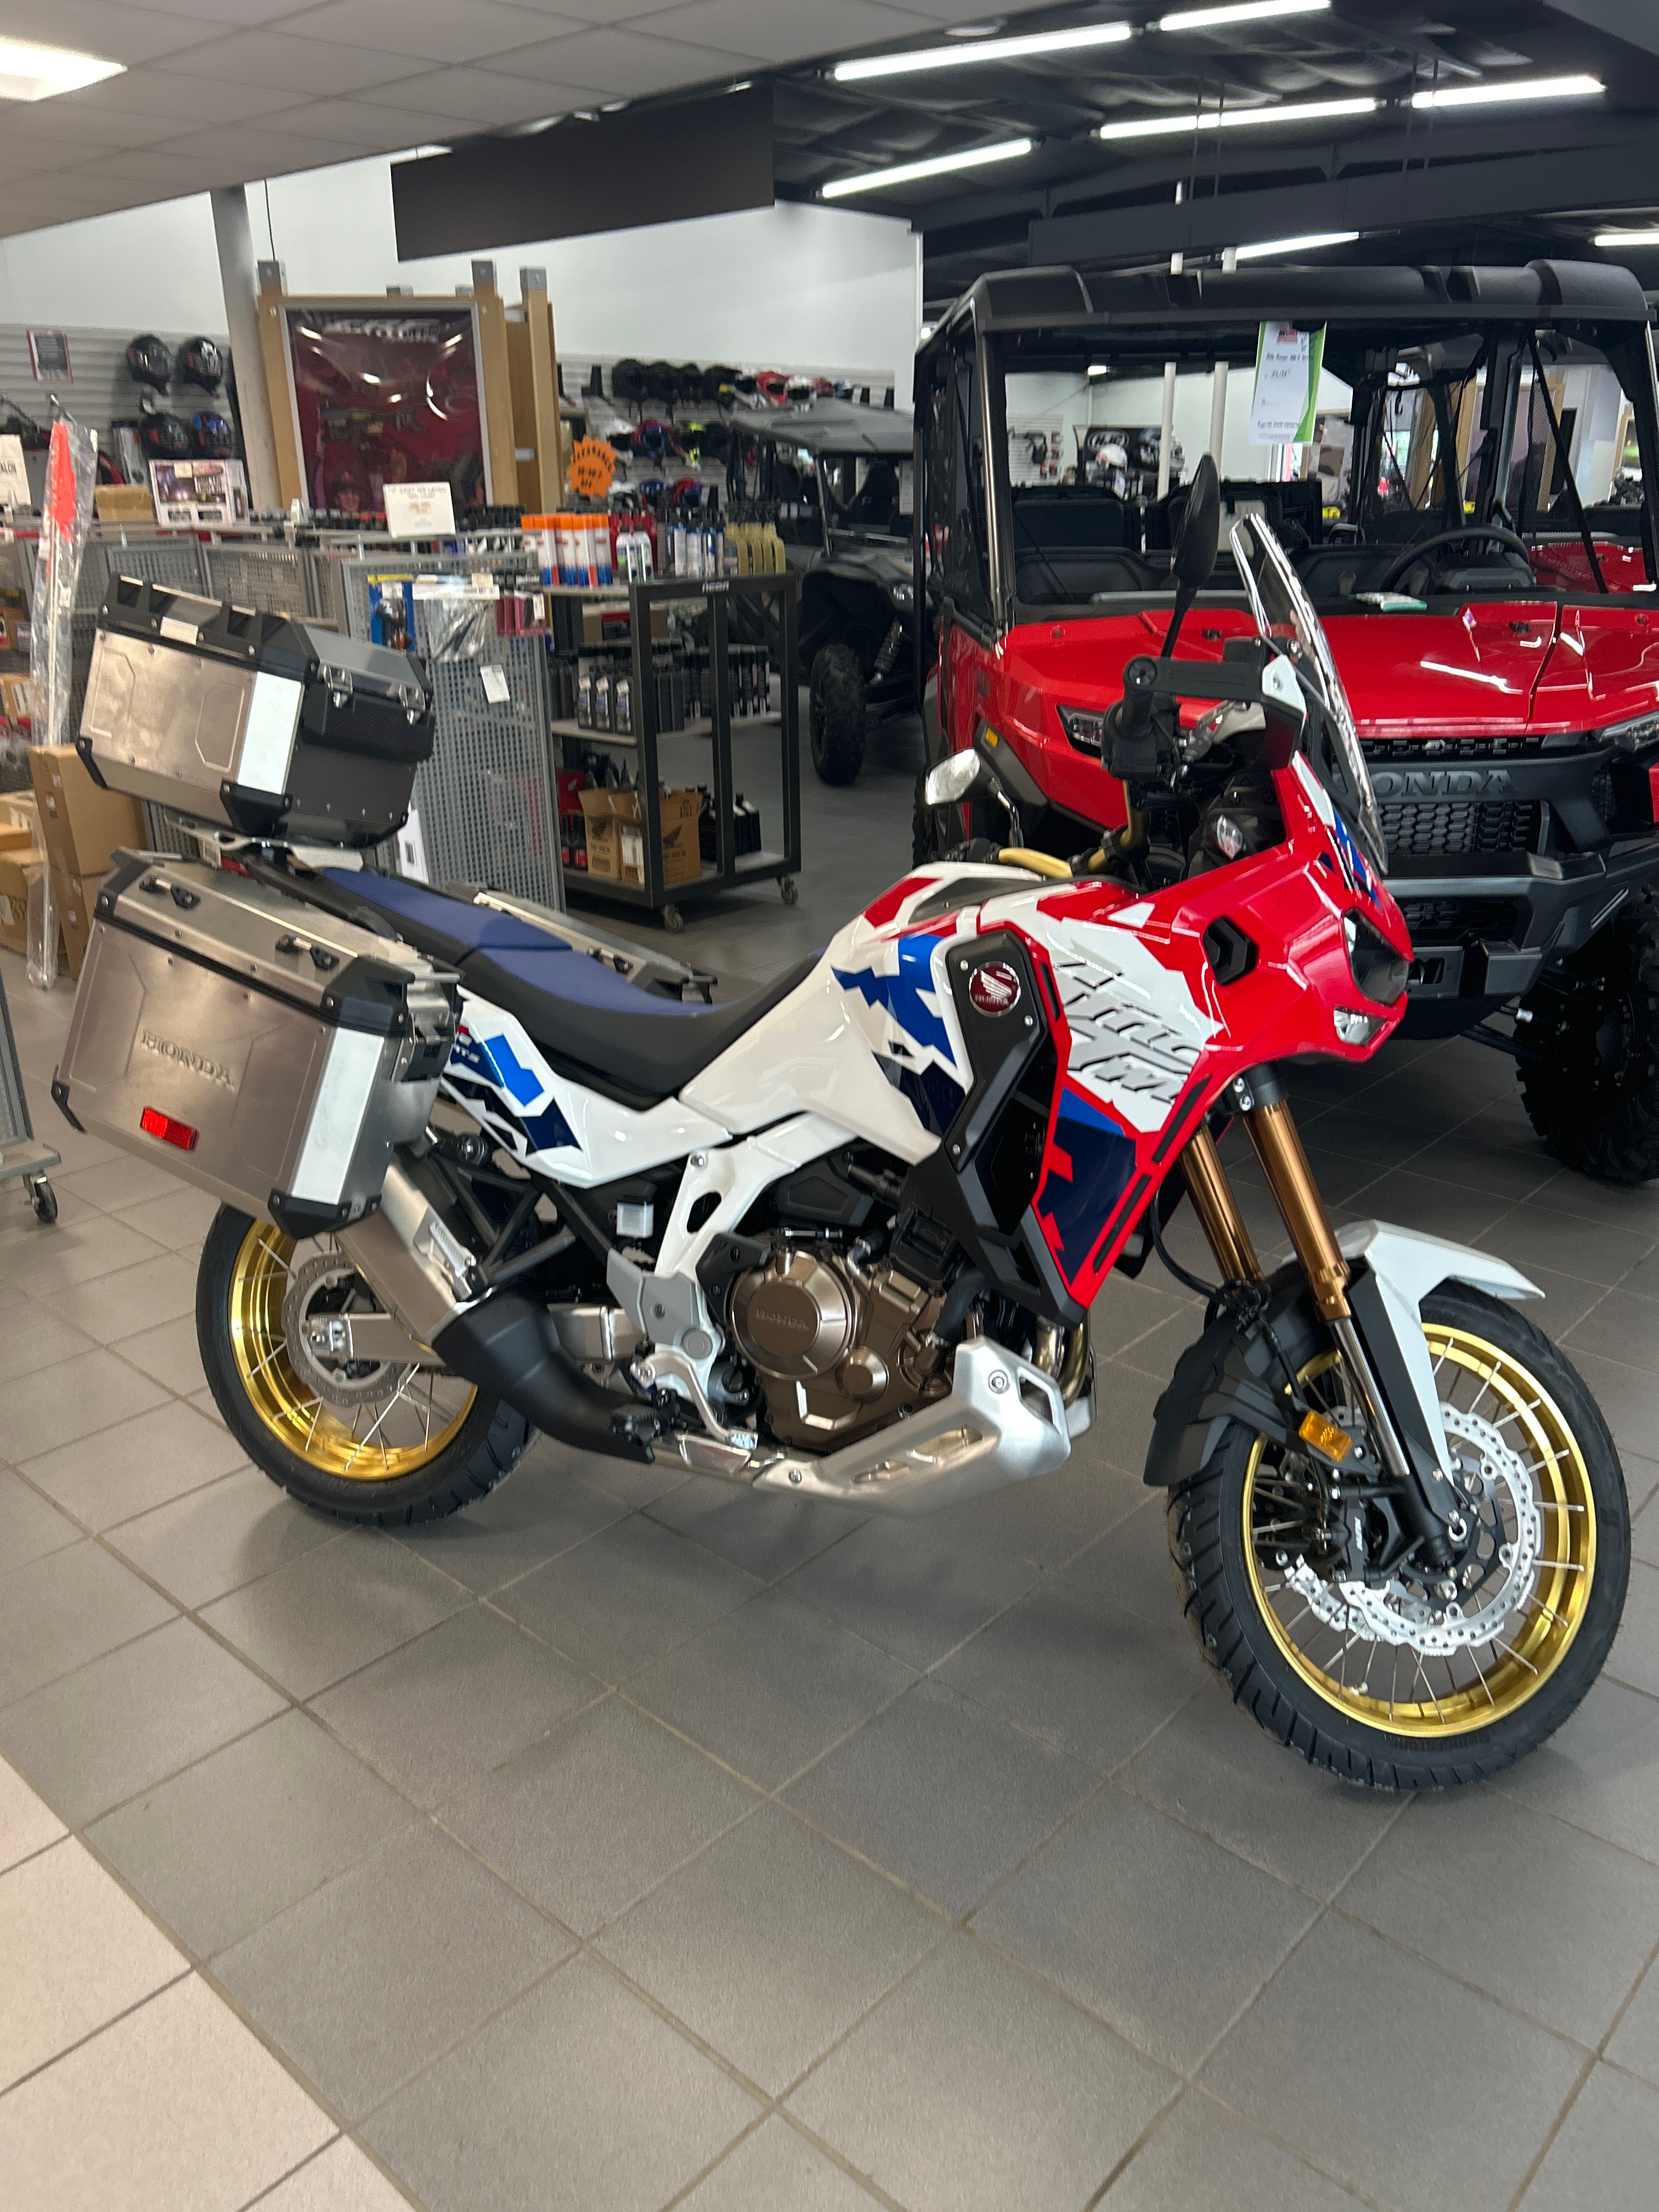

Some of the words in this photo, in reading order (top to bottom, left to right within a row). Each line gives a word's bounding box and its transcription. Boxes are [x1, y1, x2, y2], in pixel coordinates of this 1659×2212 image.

[1370, 769, 1517, 796] ONDA
[140, 1030, 235, 1093] HONDA
[755, 1308, 809, 1332] HONDA
